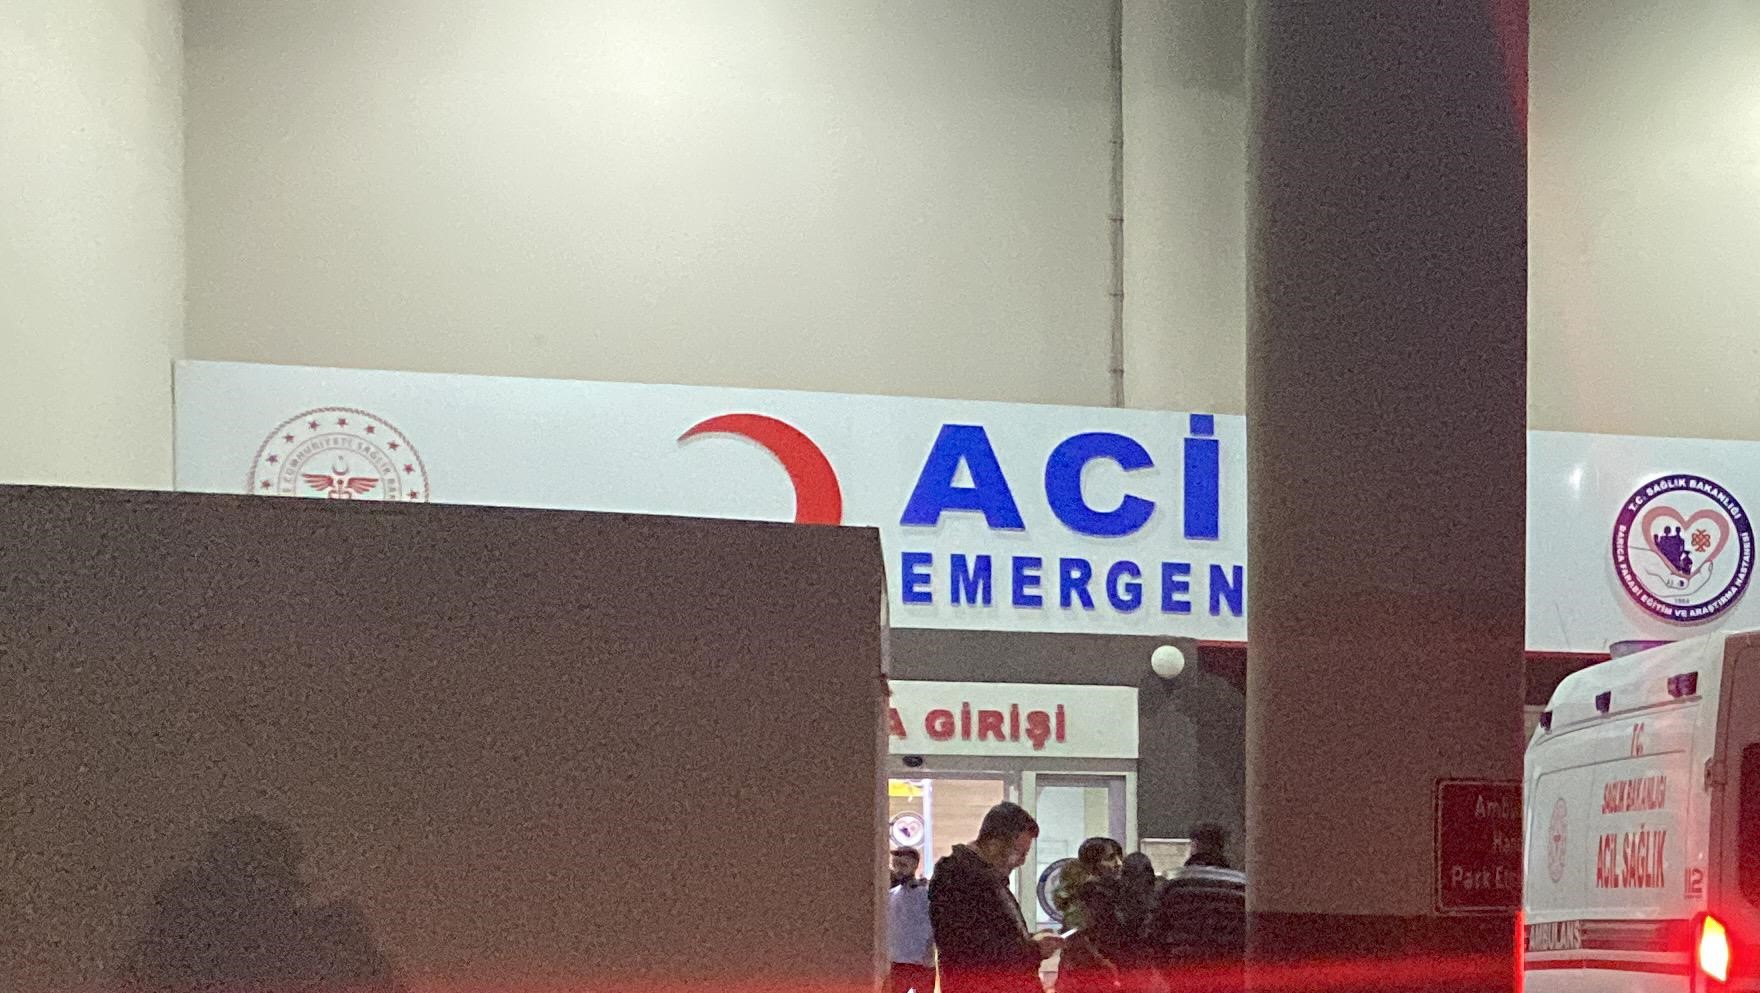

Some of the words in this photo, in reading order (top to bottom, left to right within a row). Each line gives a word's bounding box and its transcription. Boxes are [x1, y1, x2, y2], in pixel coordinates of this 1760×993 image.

[899, 413, 1219, 540] ACİ
[1646, 478, 1687, 497] SAĞLIK
[1689, 479, 1743, 520] BAKANLIĞI
[901, 551, 1243, 617] EMERGEN
[1619, 565, 1642, 597] FARABİ
[1640, 594, 1673, 616] EĞİTİM
[1674, 609, 1688, 618] VE
[1689, 586, 1738, 618] ARAŞTIRMA
[925, 701, 1066, 750] GİRİŞİ
[1622, 823, 1666, 888] SAĞLIK
